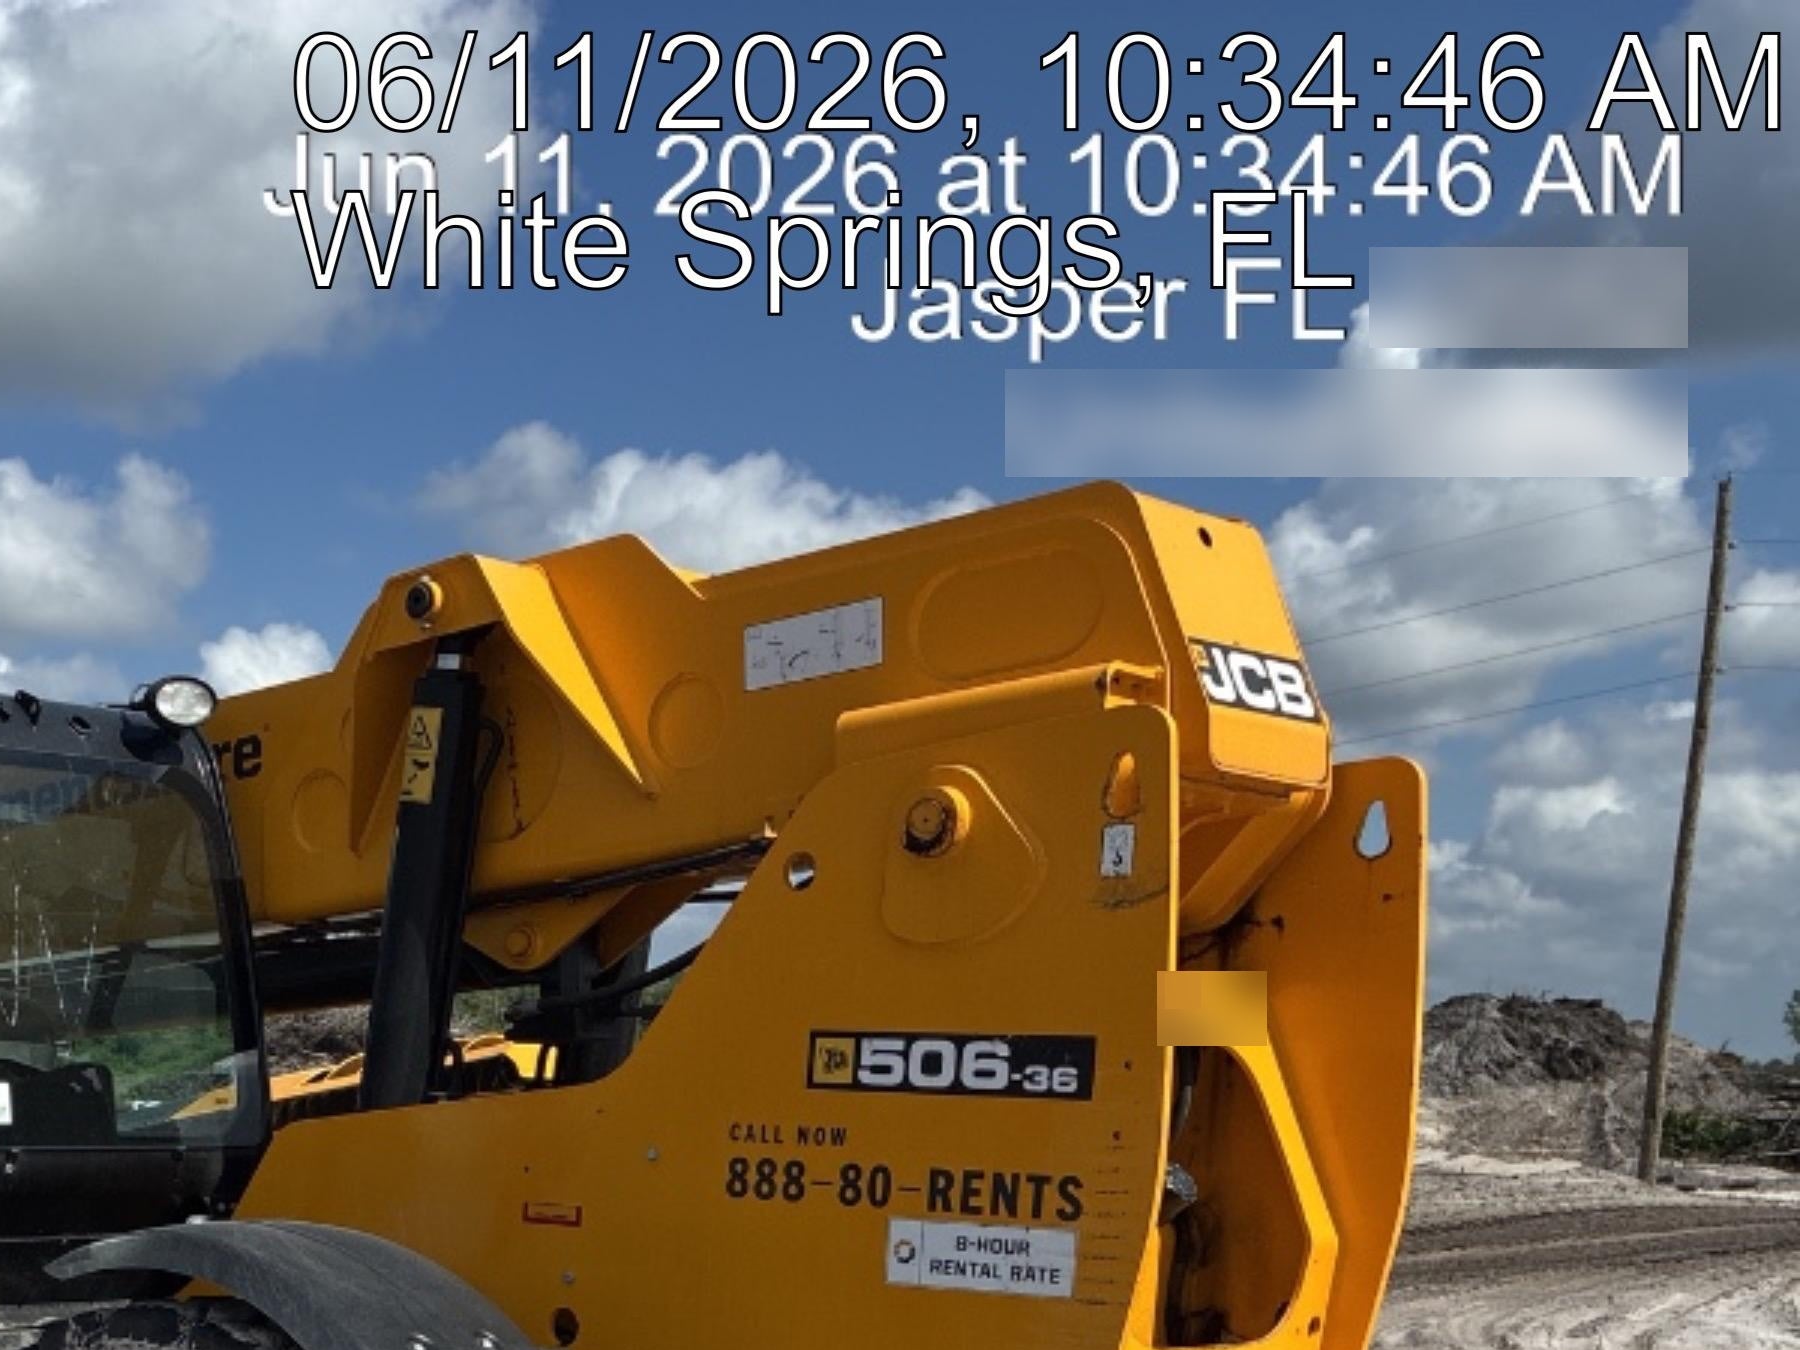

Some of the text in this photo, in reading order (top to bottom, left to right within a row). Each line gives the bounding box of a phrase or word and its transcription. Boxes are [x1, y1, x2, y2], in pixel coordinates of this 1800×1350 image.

[1201, 646, 1316, 718] JCB
[729, 1122, 848, 1147] CALL NOW
[725, 1157, 1084, 1222] 888-80-RENTS
[928, 1260, 1062, 1286] RENTAL RATE
